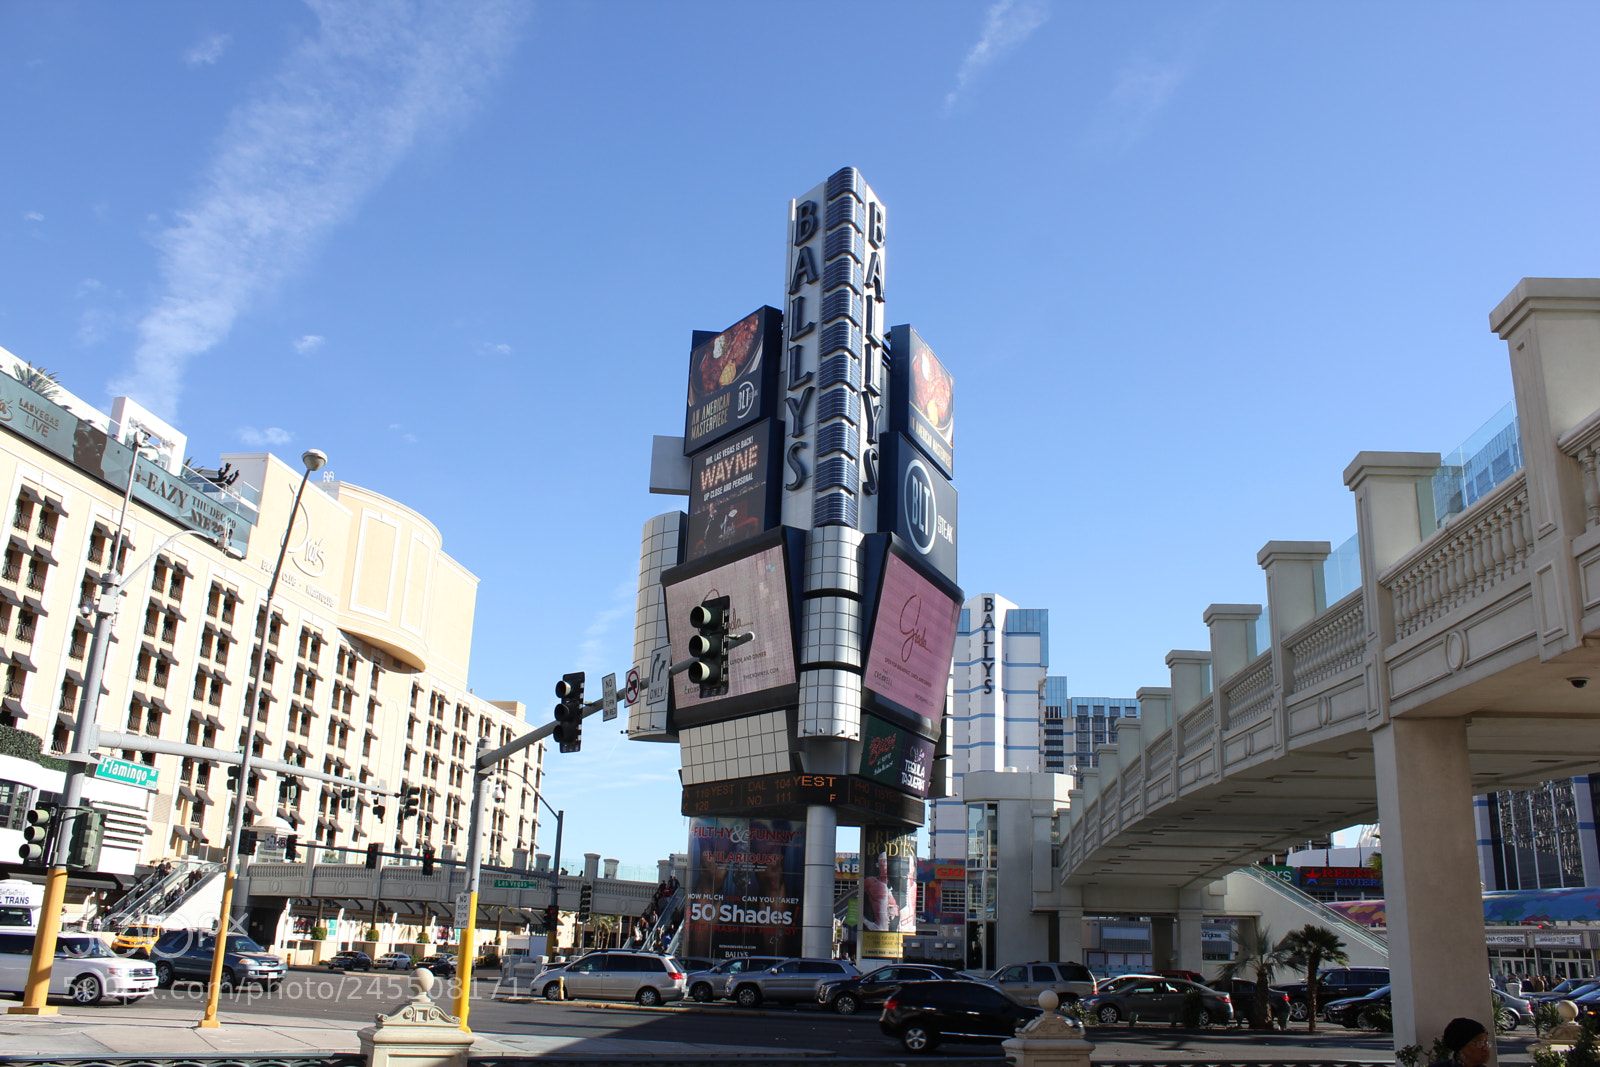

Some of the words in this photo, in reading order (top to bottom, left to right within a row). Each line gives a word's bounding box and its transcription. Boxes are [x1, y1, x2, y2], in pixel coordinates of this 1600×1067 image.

[702, 391, 731, 420] AMERICAN
[738, 387, 750, 411] BLT
[25, 415, 49, 438] LIVE
[691, 408, 728, 440] MASTERPIECE
[722, 445, 735, 457] VEGAS
[741, 435, 754, 449] BACK!
[700, 444, 759, 491] WAYNE
[129, 464, 189, 508] G-EAZY
[209, 506, 226, 522] DEC
[703, 492, 709, 502] UP
[710, 487, 723, 499] CLOSE
[723, 482, 732, 491] AND
[732, 472, 753, 489] PERSONAL
[911, 474, 931, 536] BLT
[937, 514, 953, 545] STEAK
[981, 597, 995, 695] BALLYS
[650, 685, 665, 700] ONLY
[101, 757, 147, 784] Flamingo
[904, 759, 926, 778] TEQUILA
[711, 784, 734, 796] YEST
[748, 781, 767, 792] DAL
[775, 778, 791, 790] 104
[793, 775, 837, 787] YEST
[901, 771, 926, 792] TAQUERIA
[747, 796, 762, 806] NO
[829, 794, 836, 803] F
[867, 842, 915, 858] BODIES
[497, 880, 509, 888] Las
[510, 880, 527, 889] Vegas
[5, 896, 30, 905] TRANS
[460, 895, 468, 903] NO
[703, 893, 723, 901] MUCH
[742, 895, 757, 903] CAN
[691, 903, 716, 921] 50
